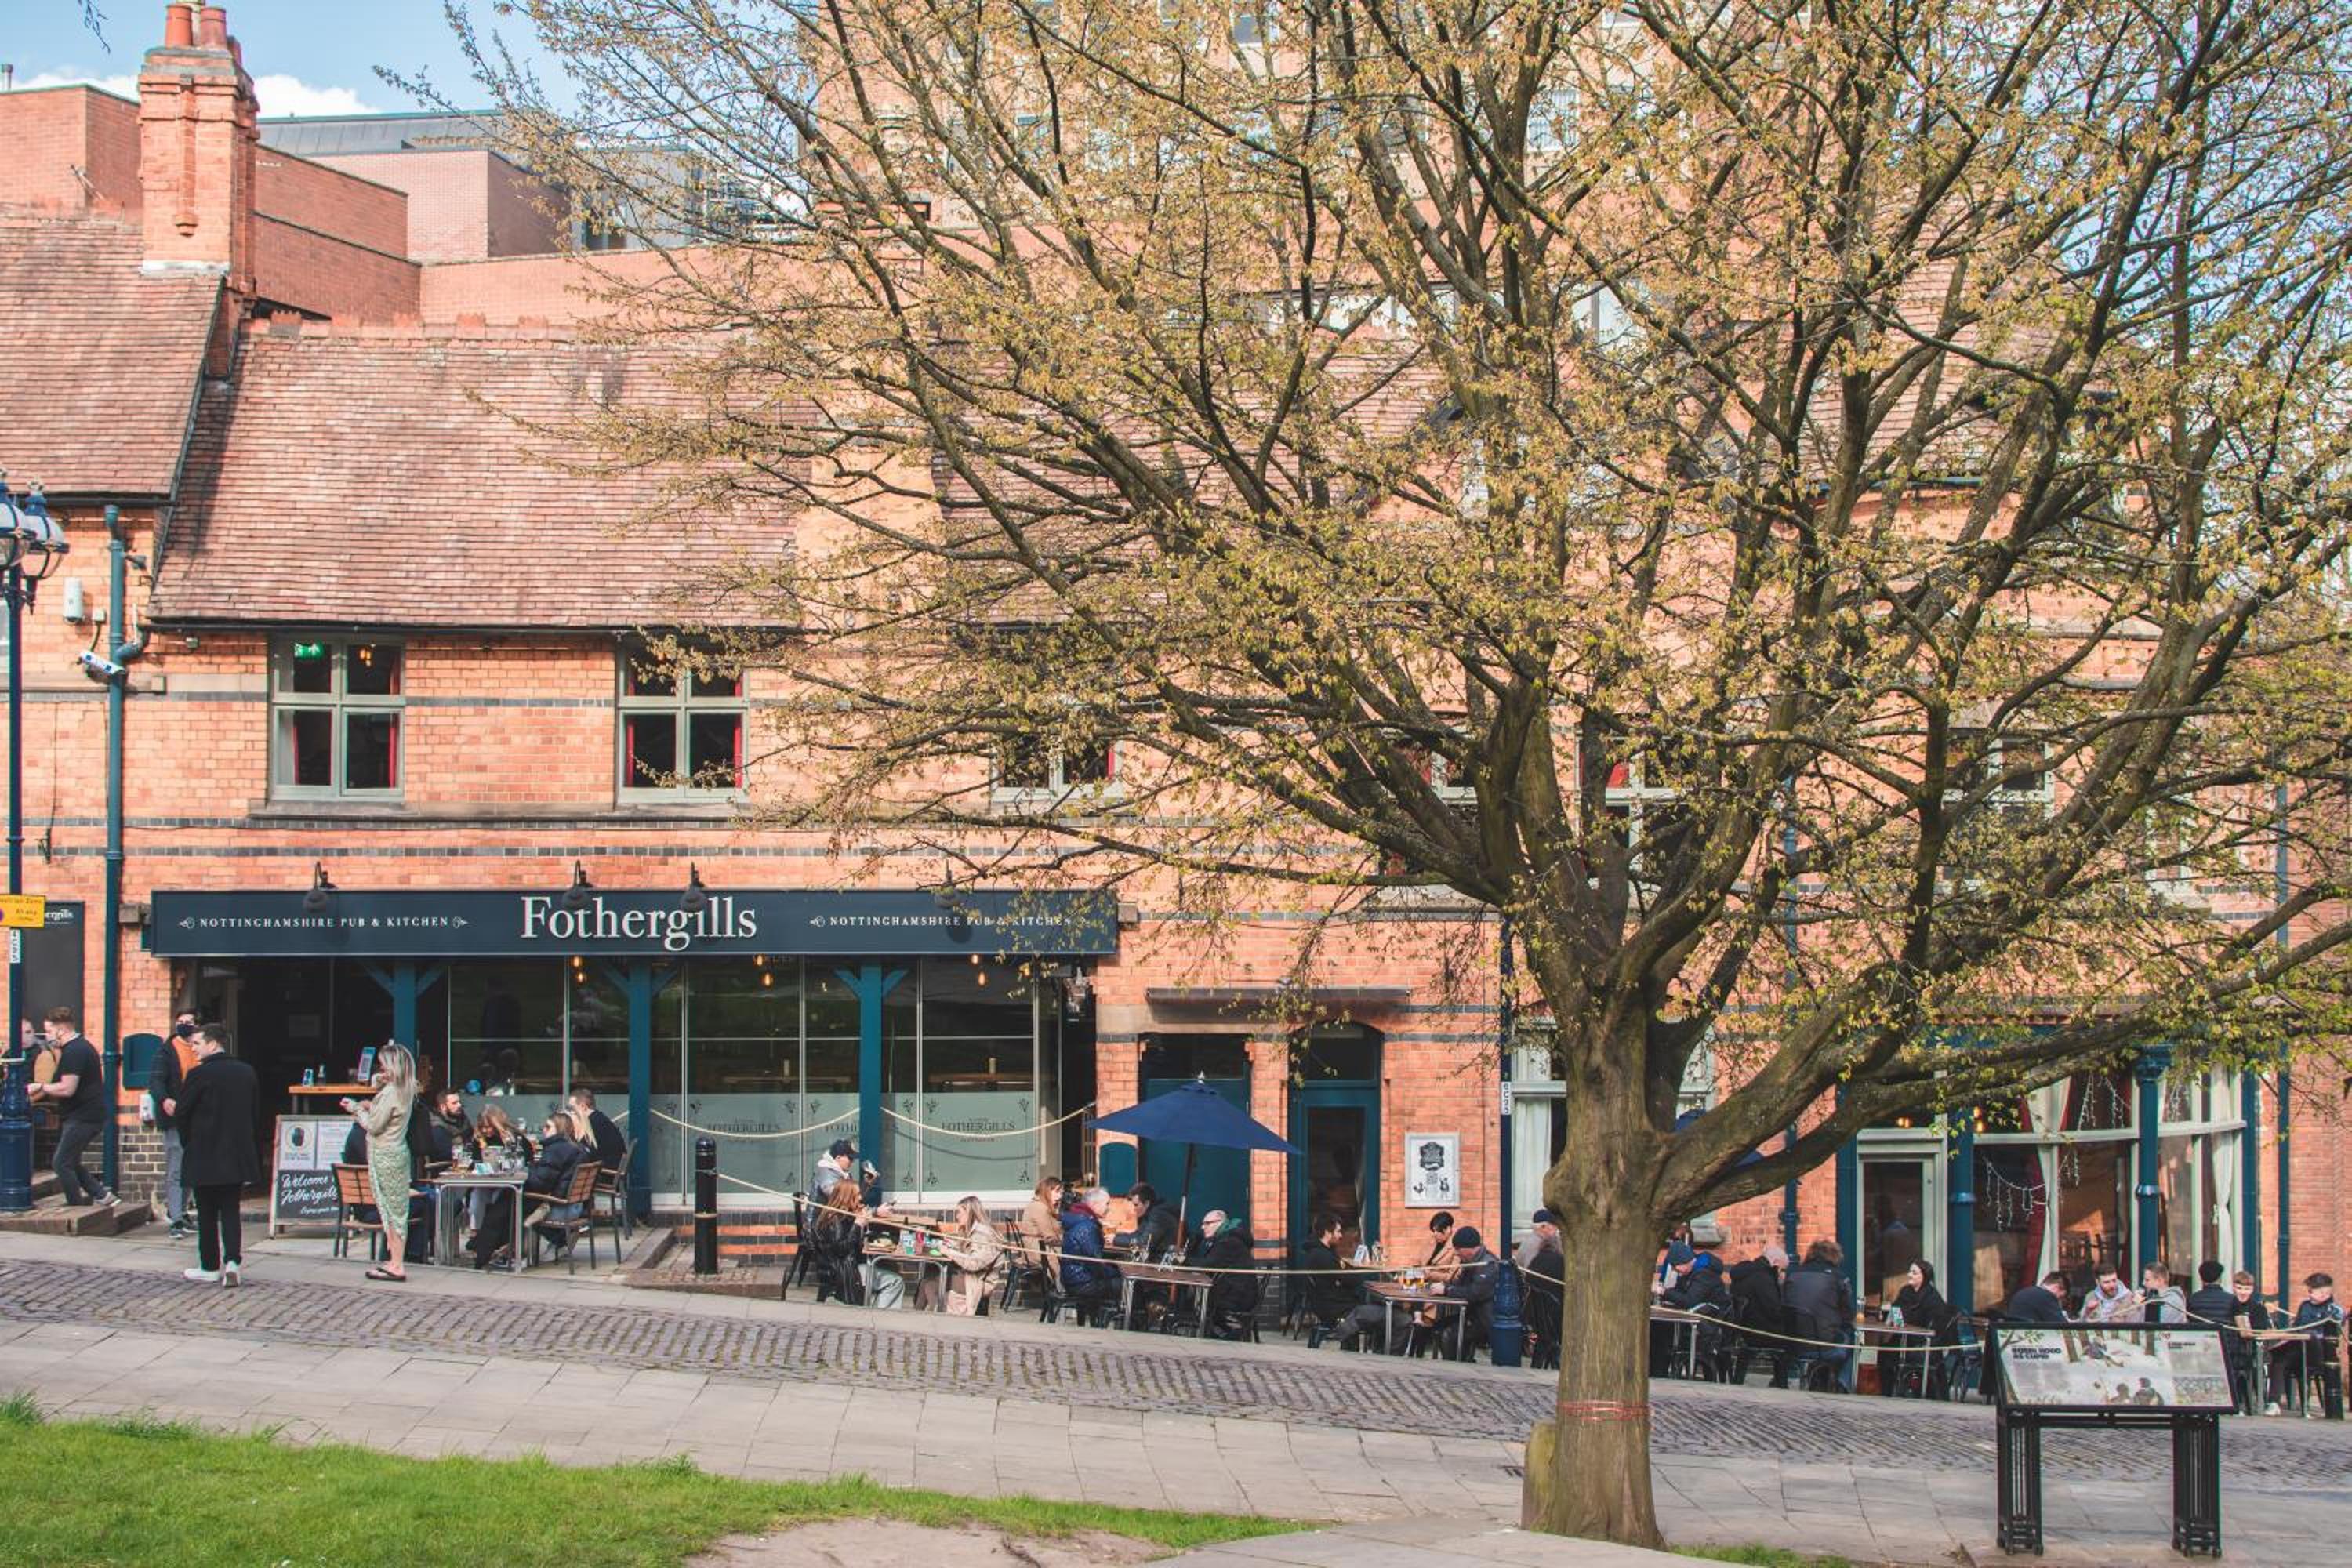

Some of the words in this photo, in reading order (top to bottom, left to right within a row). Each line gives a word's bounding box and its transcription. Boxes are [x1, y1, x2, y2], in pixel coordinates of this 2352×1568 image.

[200, 917, 334, 928] NOTTINGHAMSHIRE
[341, 917, 365, 927] PUB
[371, 917, 379, 927] &
[387, 916, 448, 927] KITCHEN
[520, 896, 757, 951] Fothergills
[829, 916, 961, 927] NOTTINGHAMSHIRE
[967, 916, 991, 927] PUB
[942, 1122, 1016, 1132] FOTHERGILLS
